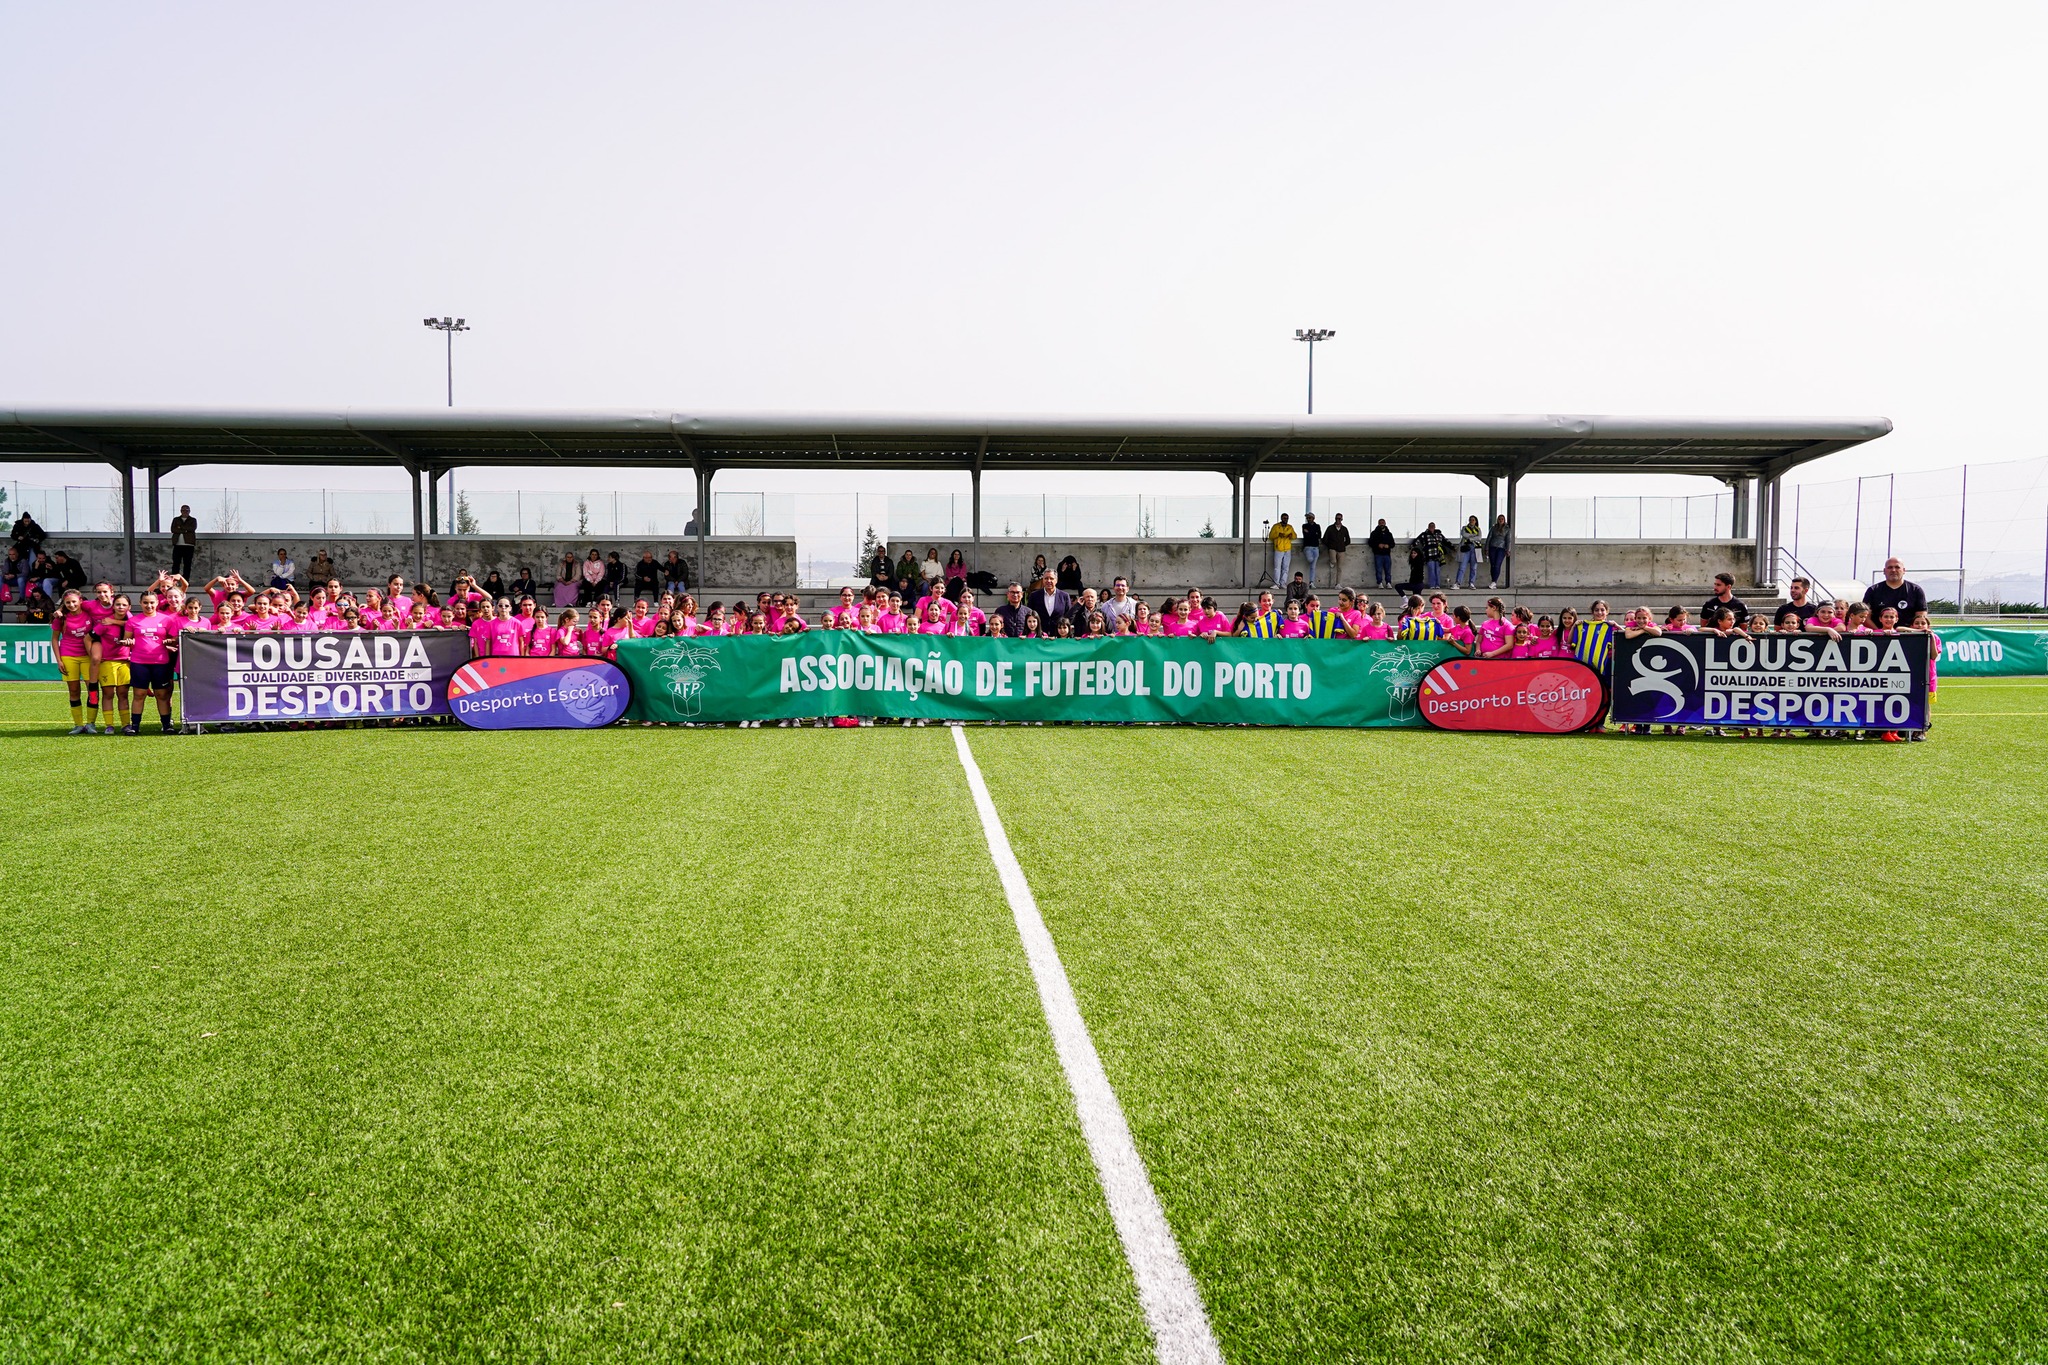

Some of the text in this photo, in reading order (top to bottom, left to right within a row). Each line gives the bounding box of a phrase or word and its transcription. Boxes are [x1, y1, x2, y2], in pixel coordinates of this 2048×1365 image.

[226, 635, 432, 671] LOUSADA
[1705, 637, 1911, 672] LOUSADA
[1945, 640, 2003, 662] PORTO
[242, 670, 420, 683] QUALIDADE E DIVERSIDADE NO
[674, 682, 701, 699] AFP
[779, 651, 1312, 701] ASSOCIAÇÃO DE FUTEBOL DO PORTO
[1710, 675, 1906, 689] QUALIDADE E DIVERSIDADE NO
[228, 682, 433, 716] DESPORTO
[459, 693, 543, 714] Desporto
[548, 683, 619, 702] Escolar
[1393, 687, 1418, 703] AFP
[1428, 687, 1591, 714] Desporto Escolar
[1703, 691, 1911, 724] DESPORTO
